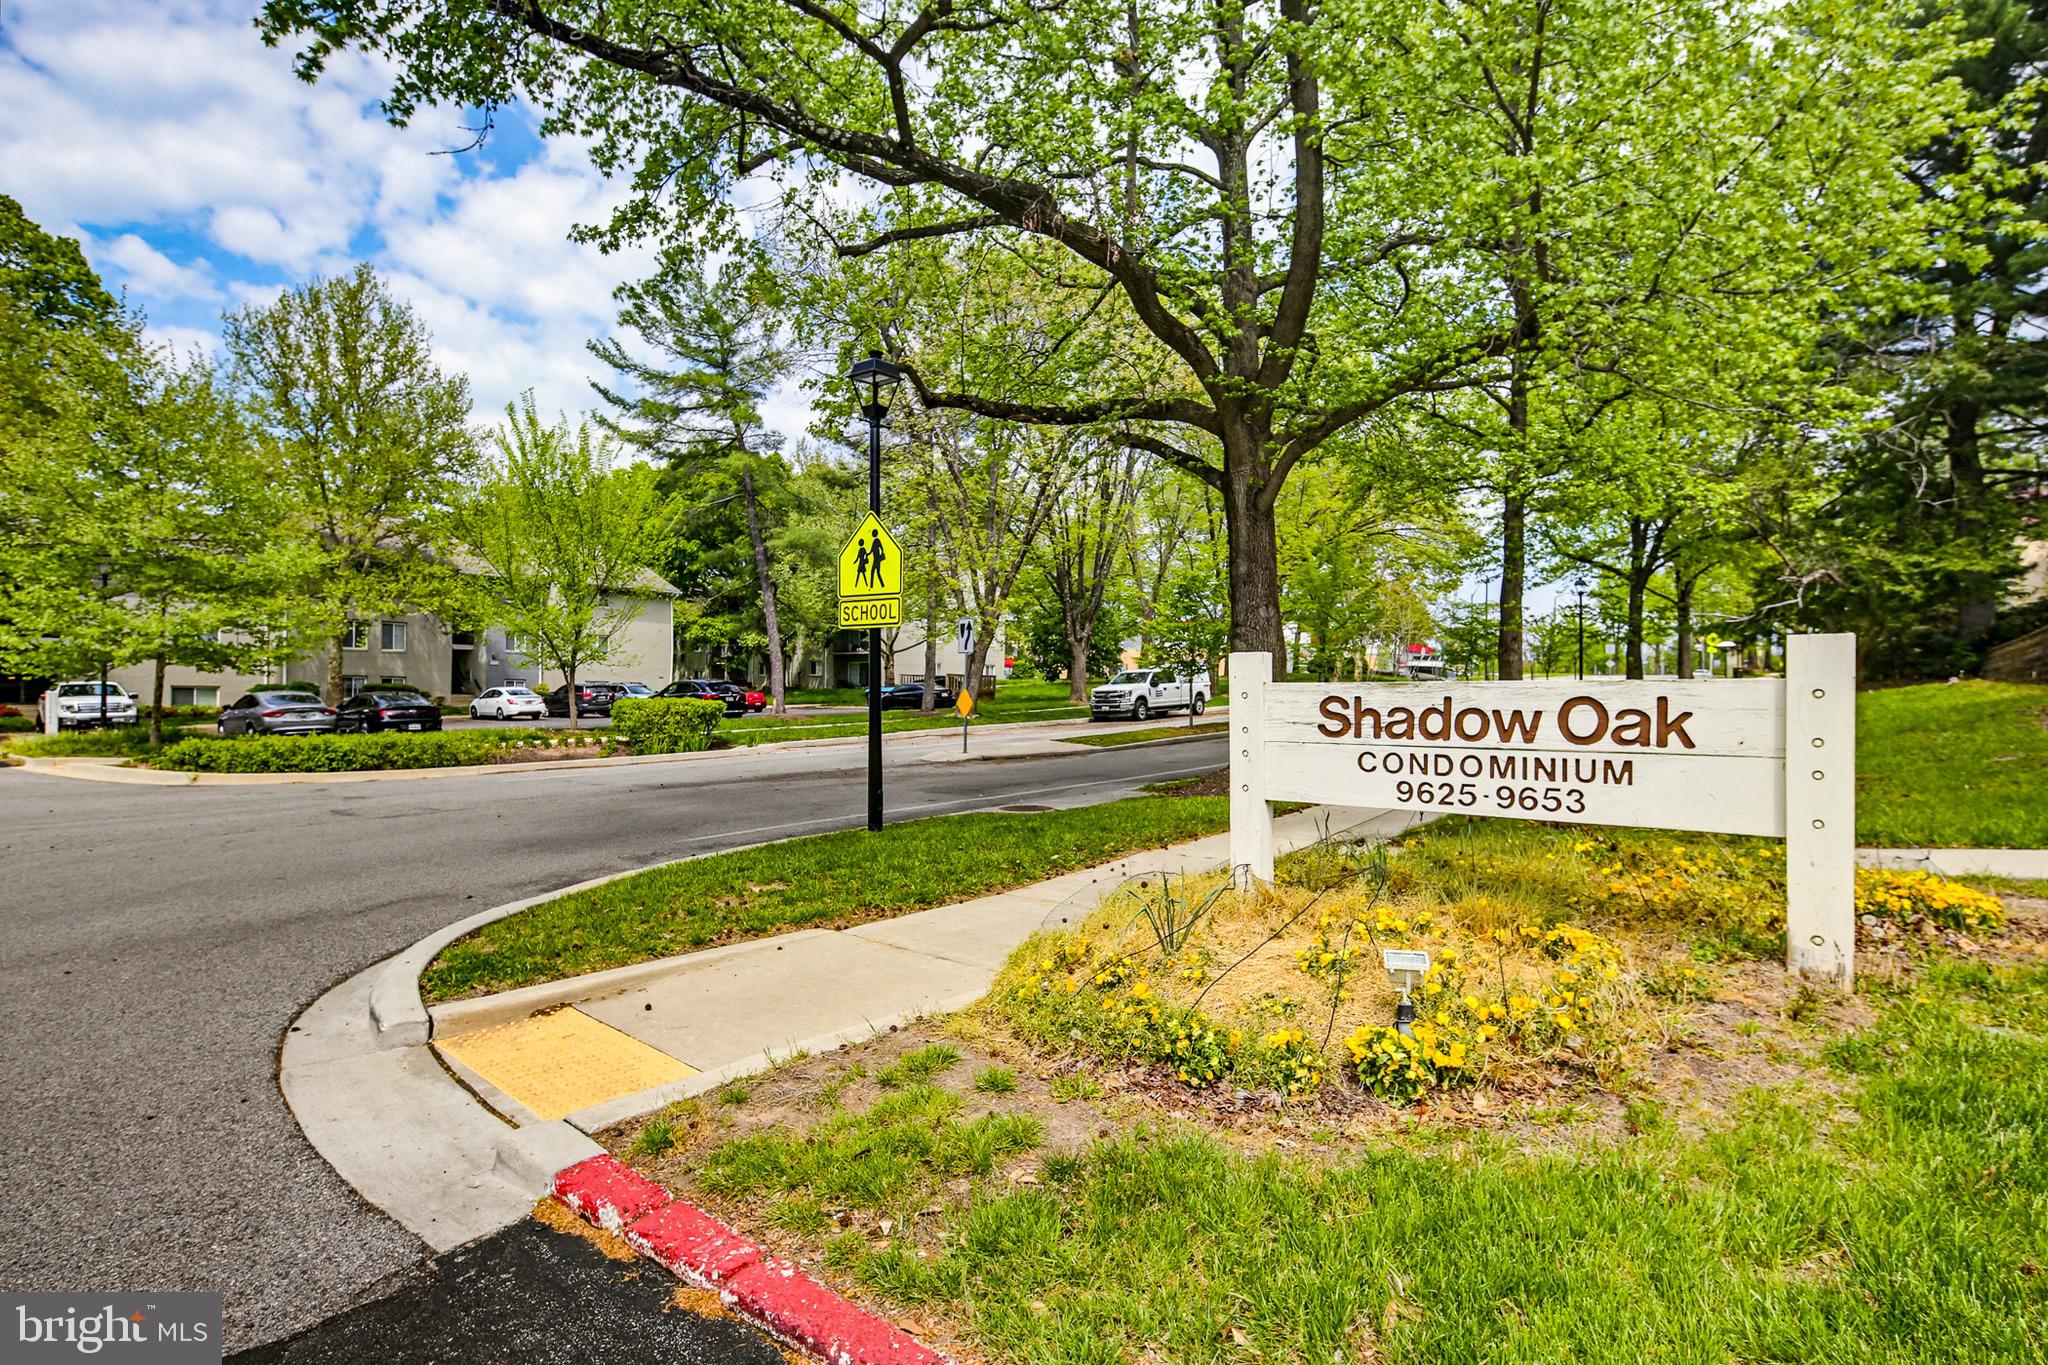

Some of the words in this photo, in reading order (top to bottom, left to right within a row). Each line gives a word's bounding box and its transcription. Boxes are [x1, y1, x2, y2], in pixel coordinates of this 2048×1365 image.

[844, 604, 896, 621] SCHOOL
[1317, 695, 1543, 743] Shadow
[1558, 695, 1696, 748] Oak
[1358, 751, 1633, 786] CONDOMINIUM
